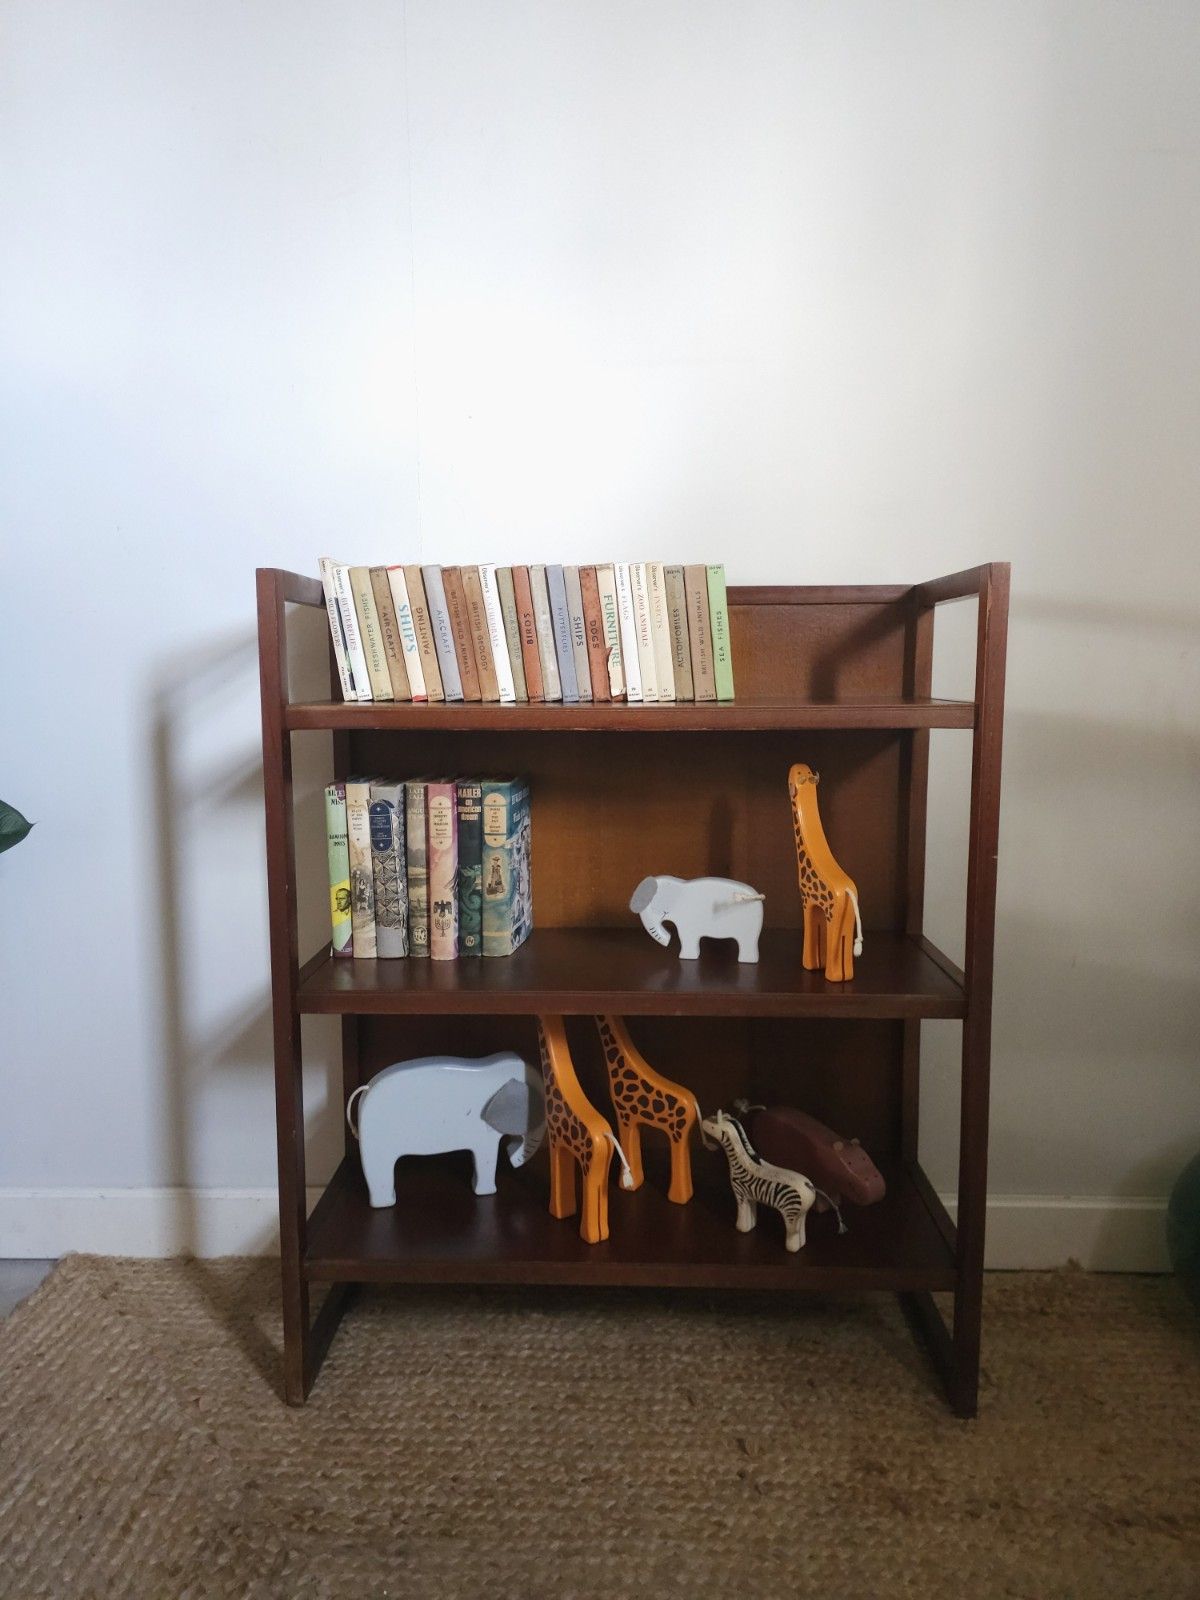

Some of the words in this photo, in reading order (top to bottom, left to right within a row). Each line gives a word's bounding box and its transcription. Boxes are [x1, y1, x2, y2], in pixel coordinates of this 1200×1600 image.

[361, 592, 370, 619] FISHES
[450, 591, 460, 619] BRITISH
[472, 601, 482, 632] BRITISH
[621, 595, 630, 621] FLAGS
[637, 593, 645, 611] ZOO
[694, 591, 702, 624] ANIMALS
[342, 597, 357, 652] BUTTERFLIES
[382, 610, 397, 660] AIRCRAFT
[399, 604, 416, 653] SHIPS
[416, 607, 431, 656] PAINTING
[438, 609, 451, 655] AIRCRAFT
[455, 620, 464, 640] WILD
[524, 612, 534, 646] BIRDS
[558, 607, 568, 654] BUTTERFLIES
[573, 616, 583, 647] SHIPS
[590, 620, 600, 649] DOGS
[640, 613, 649, 648] ANIMALS
[366, 623, 382, 673] FRESHWATER
[459, 642, 470, 676] ANIMALS
[476, 634, 488, 672] GEOLOGY
[700, 649, 708, 675] BRITISH
